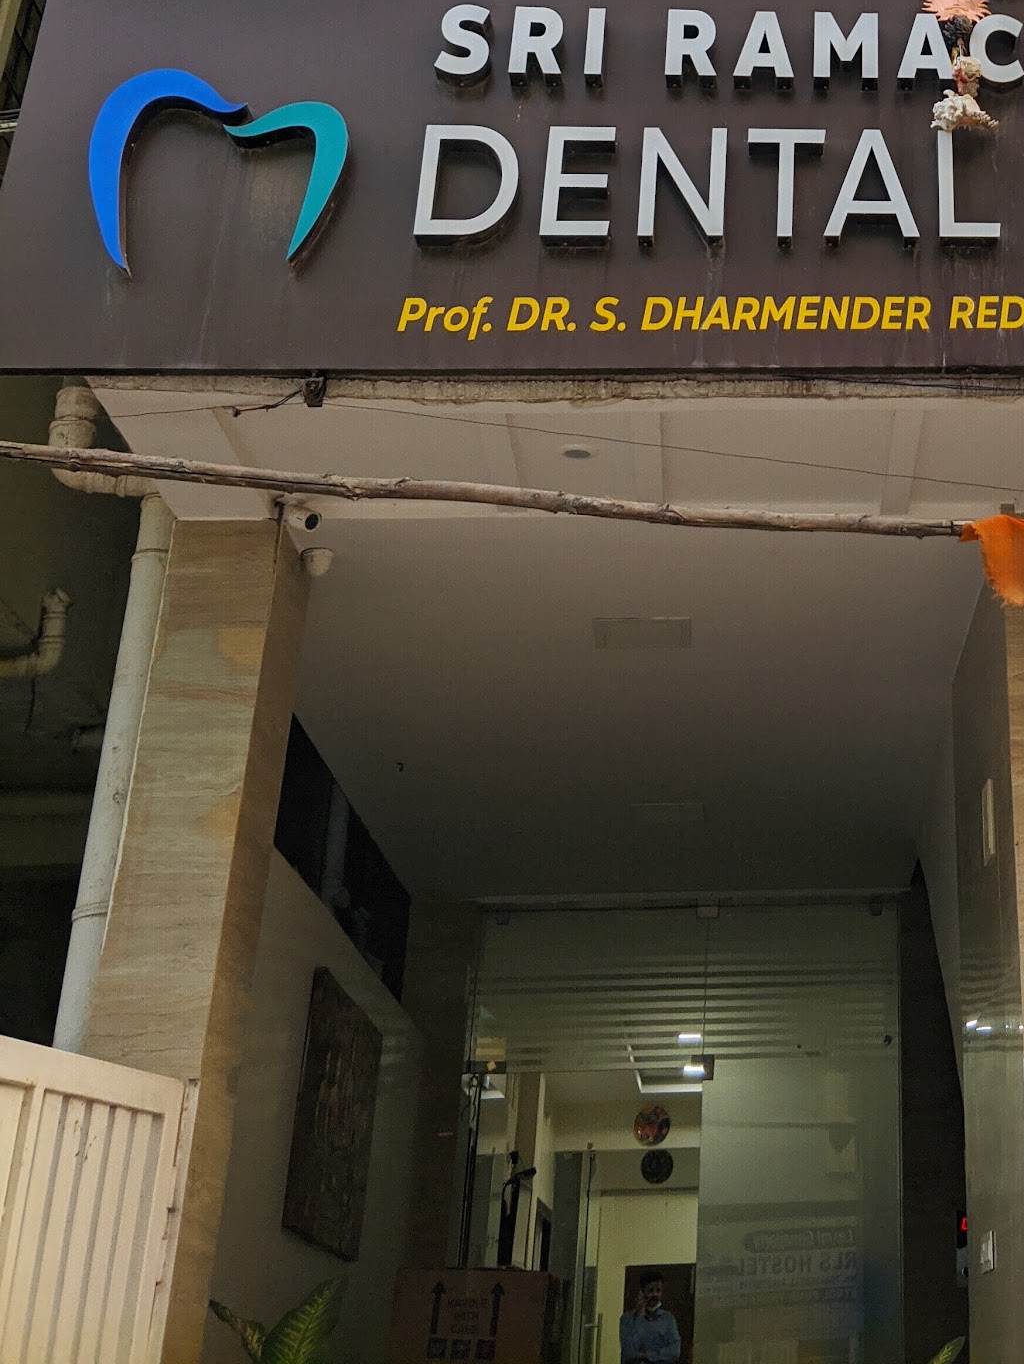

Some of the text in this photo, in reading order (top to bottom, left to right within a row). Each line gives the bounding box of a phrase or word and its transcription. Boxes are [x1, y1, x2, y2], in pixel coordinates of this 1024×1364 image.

[434, 4, 606, 76] SRI
[412, 124, 1001, 238] DENTAL
[397, 296, 494, 341] Prof.
[506, 296, 577, 332] DR.
[589, 296, 626, 332] S.
[640, 296, 932, 331] DHARMENDER
